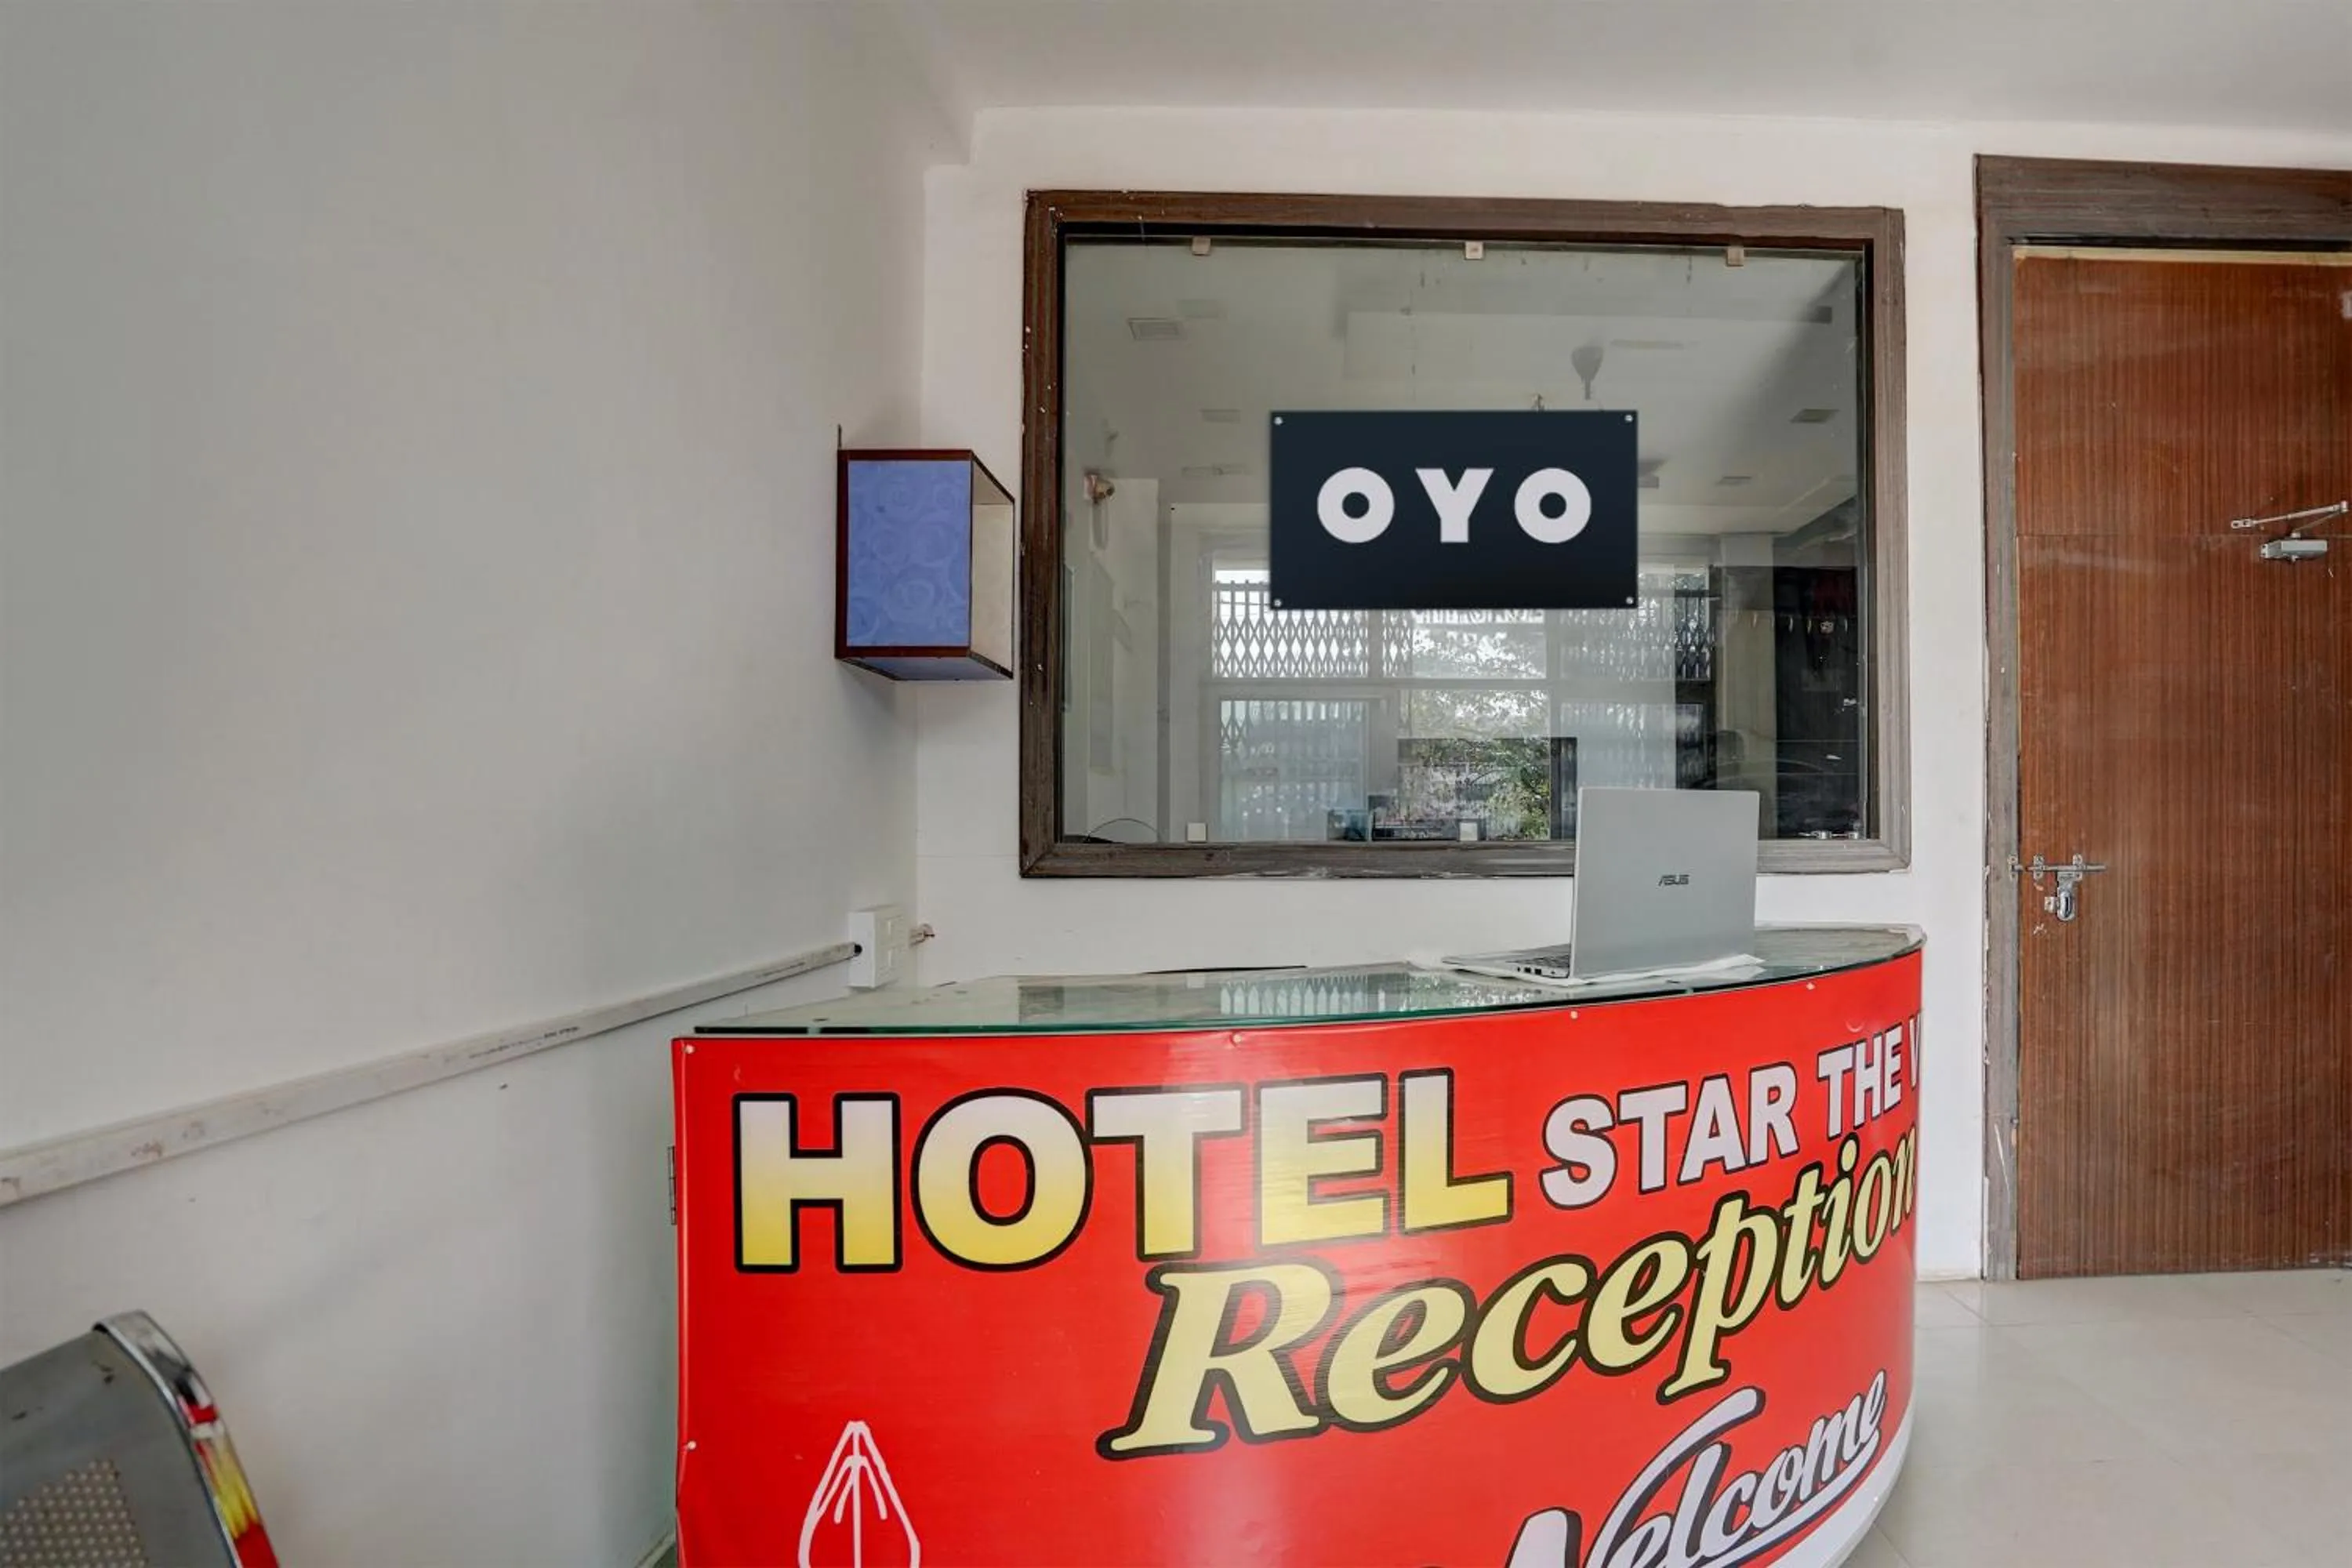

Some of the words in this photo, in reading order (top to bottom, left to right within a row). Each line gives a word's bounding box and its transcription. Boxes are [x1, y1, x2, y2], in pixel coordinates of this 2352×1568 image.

[1317, 467, 1592, 543] OYO
[1658, 874, 1690, 886] ASUS
[735, 1068, 1512, 1272] HOTEL
[1541, 1062, 1799, 1207] STAR
[1817, 1022, 1904, 1141] THE
[1098, 1127, 1916, 1458] Reception
